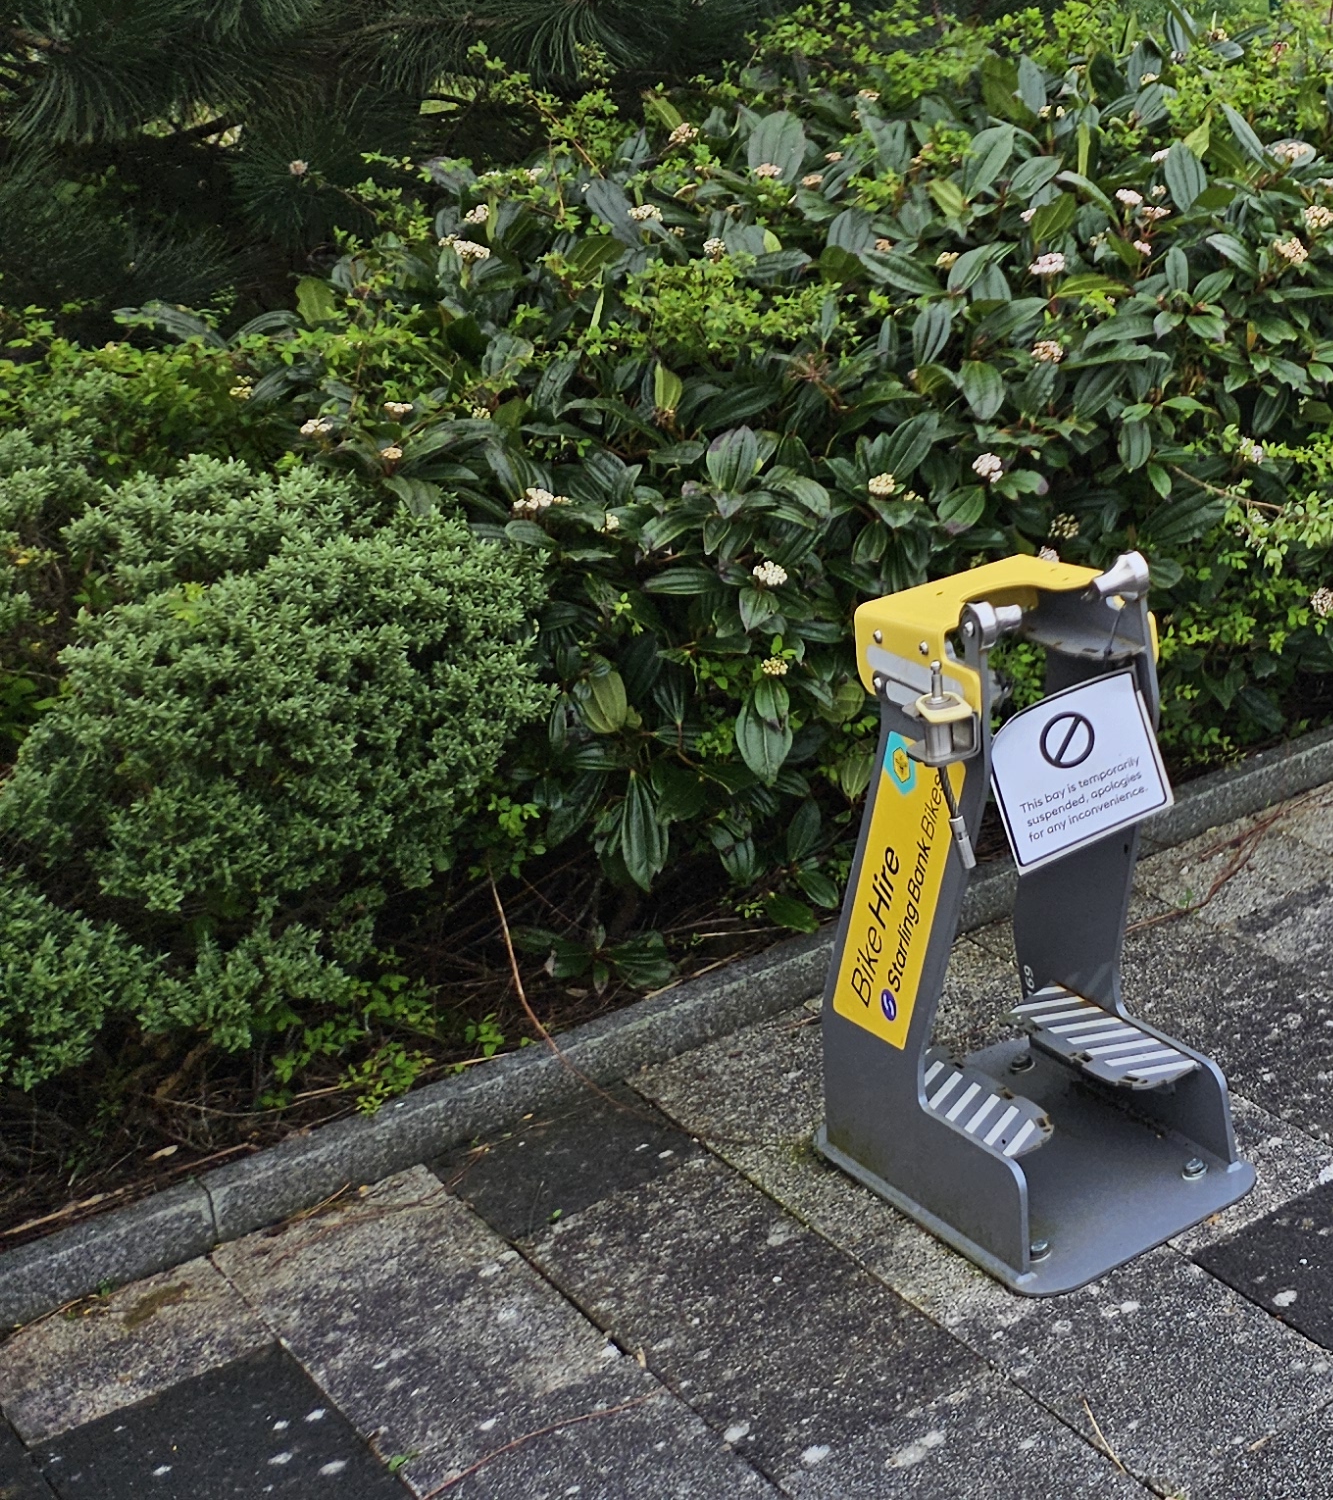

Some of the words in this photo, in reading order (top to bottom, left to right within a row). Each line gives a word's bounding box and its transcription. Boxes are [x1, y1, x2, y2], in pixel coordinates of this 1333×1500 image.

[1019, 796, 1044, 814] This
[1045, 787, 1066, 804] bay
[1067, 782, 1077, 794] is
[1078, 755, 1140, 788] temporarily
[1027, 794, 1090, 828] suspended,
[1090, 770, 1143, 800] apologies
[1028, 829, 1045, 843] for
[1046, 817, 1067, 835] any
[1068, 785, 1149, 825] inconvenience.
[887, 902, 920, 993] Starling
[908, 840, 932, 905] Bank
[921, 773, 944, 841] Bikes
[851, 925, 884, 1008] Bike
[868, 845, 900, 930] Hire
